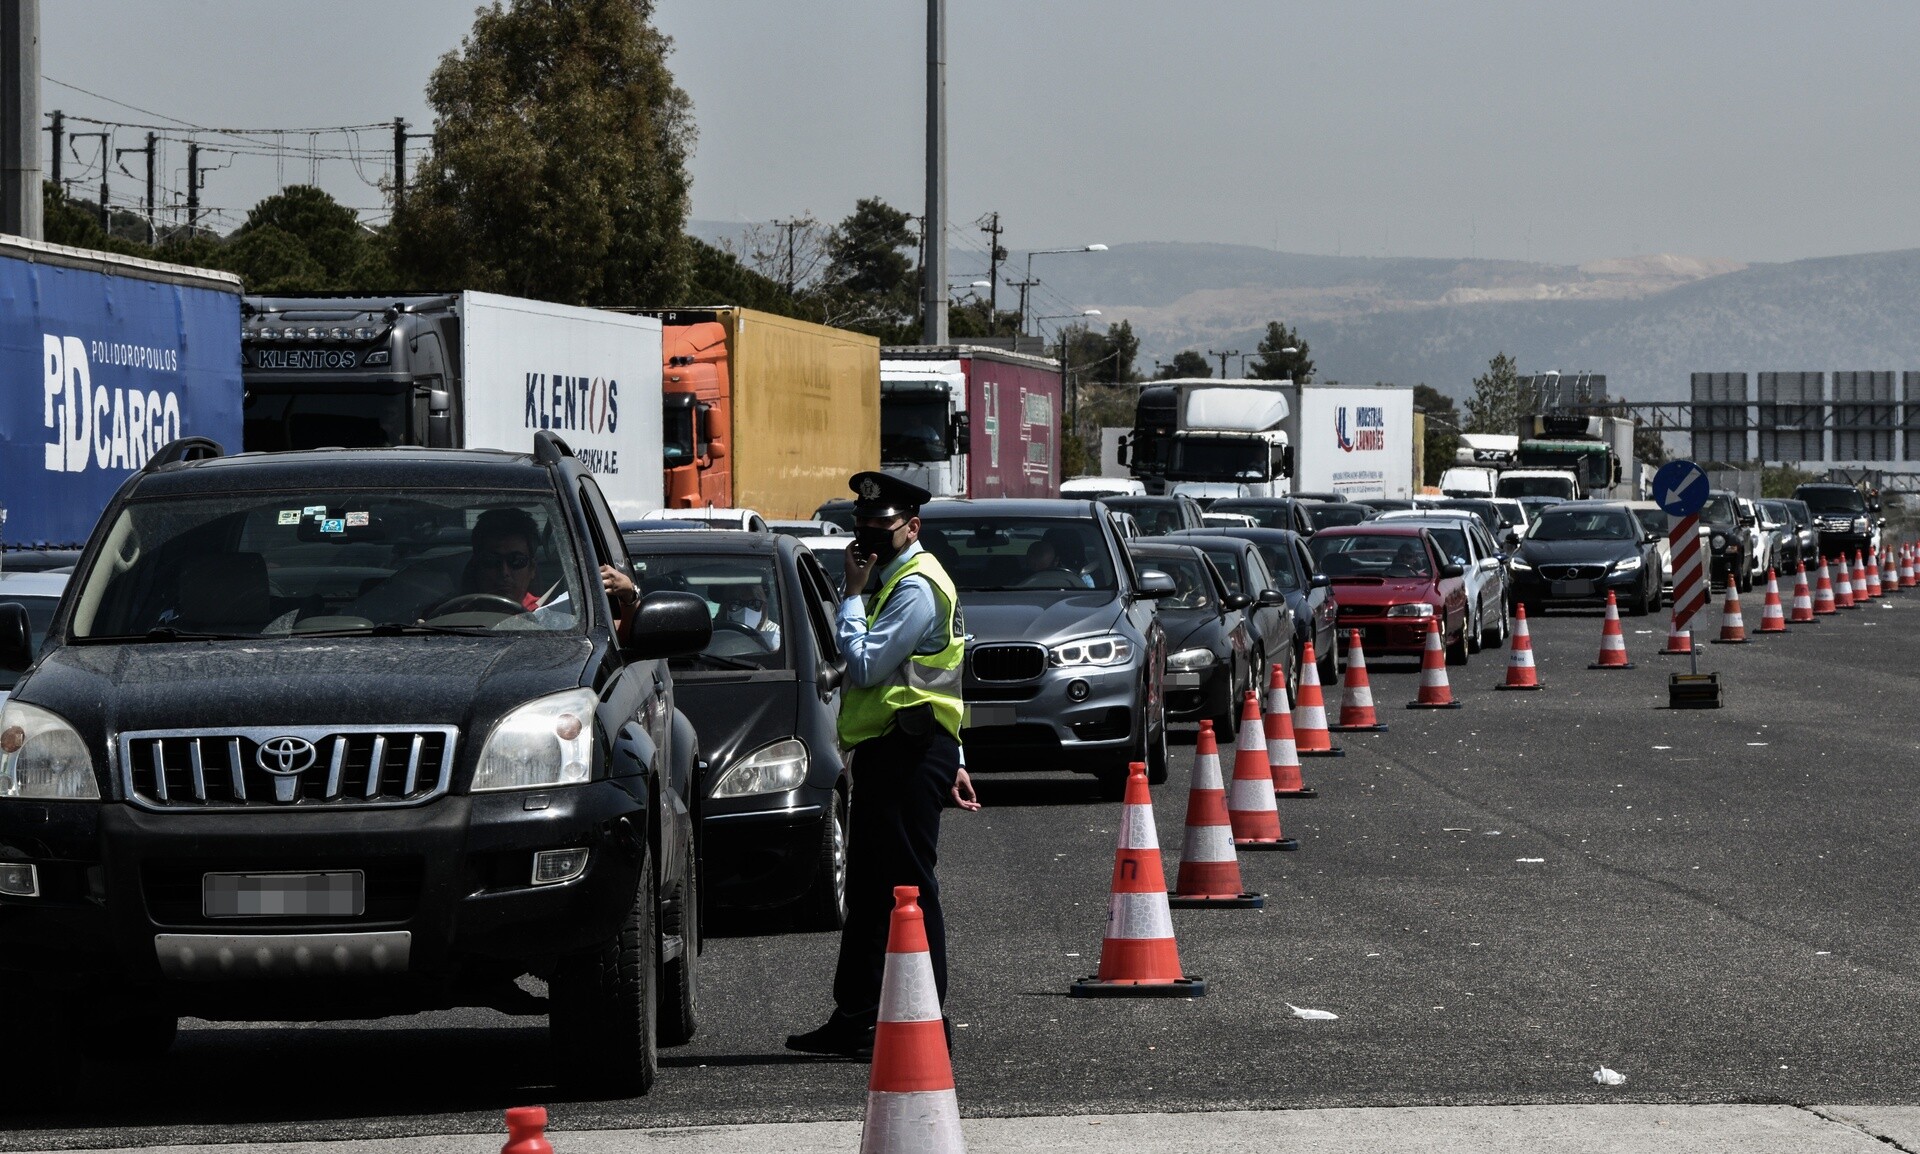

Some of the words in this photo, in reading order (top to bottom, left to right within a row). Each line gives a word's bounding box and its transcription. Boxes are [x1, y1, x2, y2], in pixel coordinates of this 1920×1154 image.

[92, 340, 178, 372] POLIDOROPOULOS
[258, 350, 356, 369] KLENTOS
[525, 372, 618, 434] KLENTOS
[94, 385, 181, 470] CARGO
[1355, 429, 1384, 451] LAUNDRIES
[1479, 450, 1507, 460] XF
